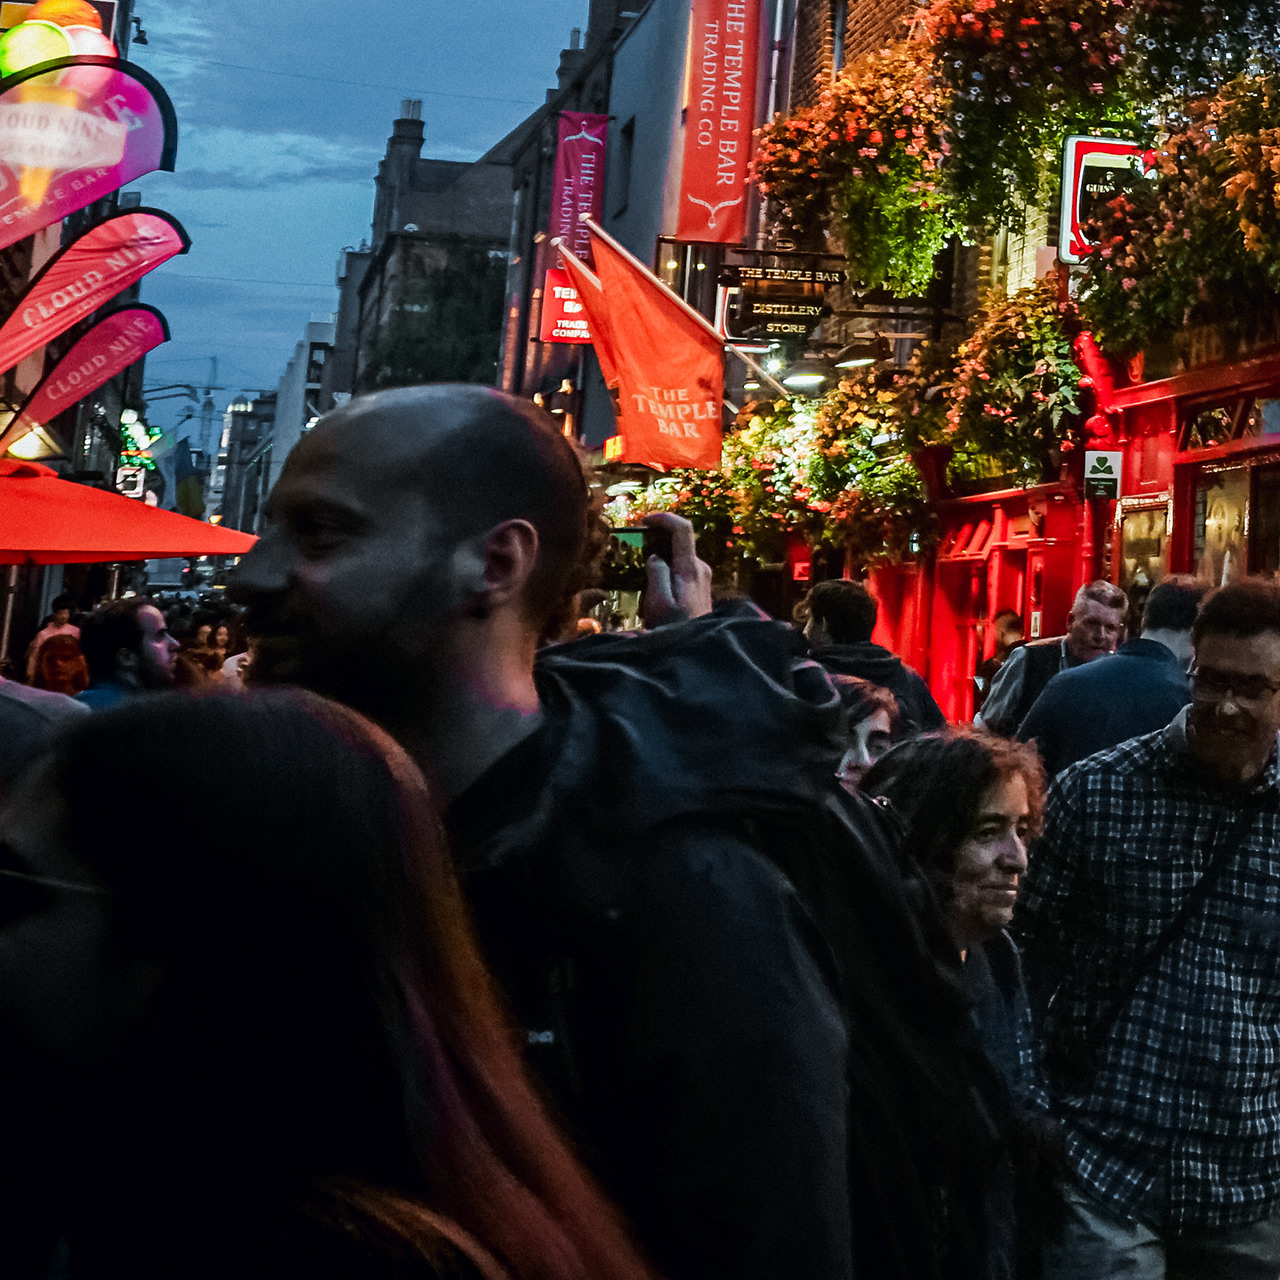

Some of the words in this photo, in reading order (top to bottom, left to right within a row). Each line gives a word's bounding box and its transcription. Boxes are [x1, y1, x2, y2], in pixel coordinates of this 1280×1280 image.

[699, 19, 720, 113] TRADING
[719, 41, 744, 133] TEMPLE
[579, 151, 596, 187] THE
[716, 139, 738, 186] BAR
[738, 267, 763, 279] THE
[765, 268, 813, 281] TEMPLE
[815, 271, 840, 283] BAR
[22, 269, 104, 329] CLOUD
[752, 303, 822, 317] DISTILLERY
[766, 323, 807, 334] STORE
[46, 354, 108, 401] CLOUD
[109, 316, 153, 355] NINE
[631, 393, 719, 421] TEMPLE
[649, 386, 690, 402] THE
[656, 417, 701, 439] BAR
